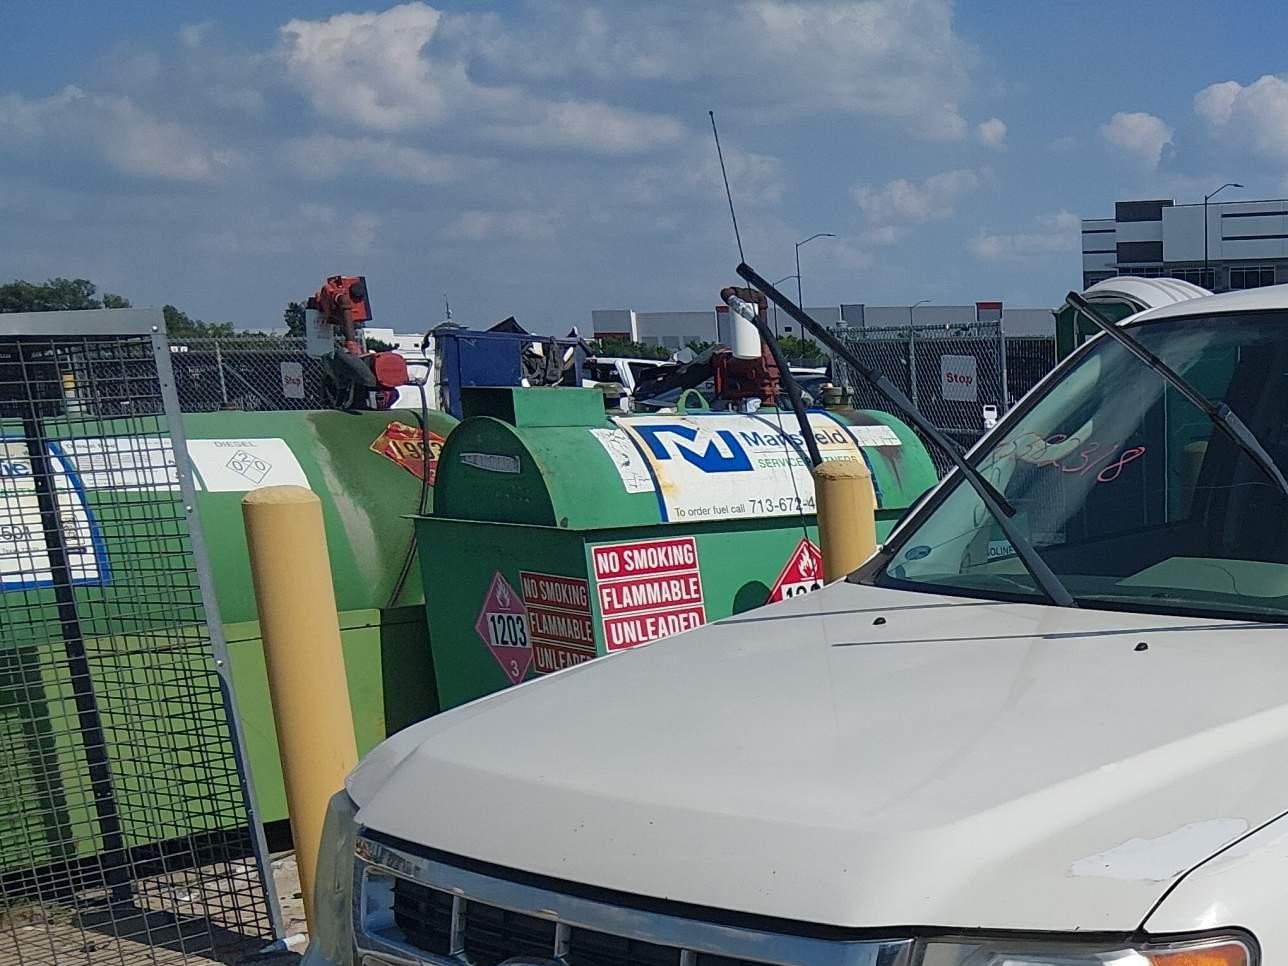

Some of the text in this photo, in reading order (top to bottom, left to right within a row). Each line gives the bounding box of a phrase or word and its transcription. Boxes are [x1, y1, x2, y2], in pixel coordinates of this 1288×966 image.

[946, 372, 973, 386] Stop
[214, 440, 257, 448] DIESEL
[739, 430, 849, 447] Manseld
[758, 455, 802, 469] SERVICE
[675, 507, 686, 518] To
[688, 504, 711, 517] order
[713, 504, 729, 515] fuel
[731, 504, 746, 515] call
[596, 544, 694, 574] NO SMOKING
[523, 577, 587, 606] NO SMOKING
[601, 577, 700, 610] FLAMMABLE
[489, 614, 527, 647] 1203
[528, 611, 593, 642] FLAMMABLE
[610, 611, 701, 645] UNLEADED
[510, 660, 519, 677] 3
[536, 646, 593, 671] UNLEA
